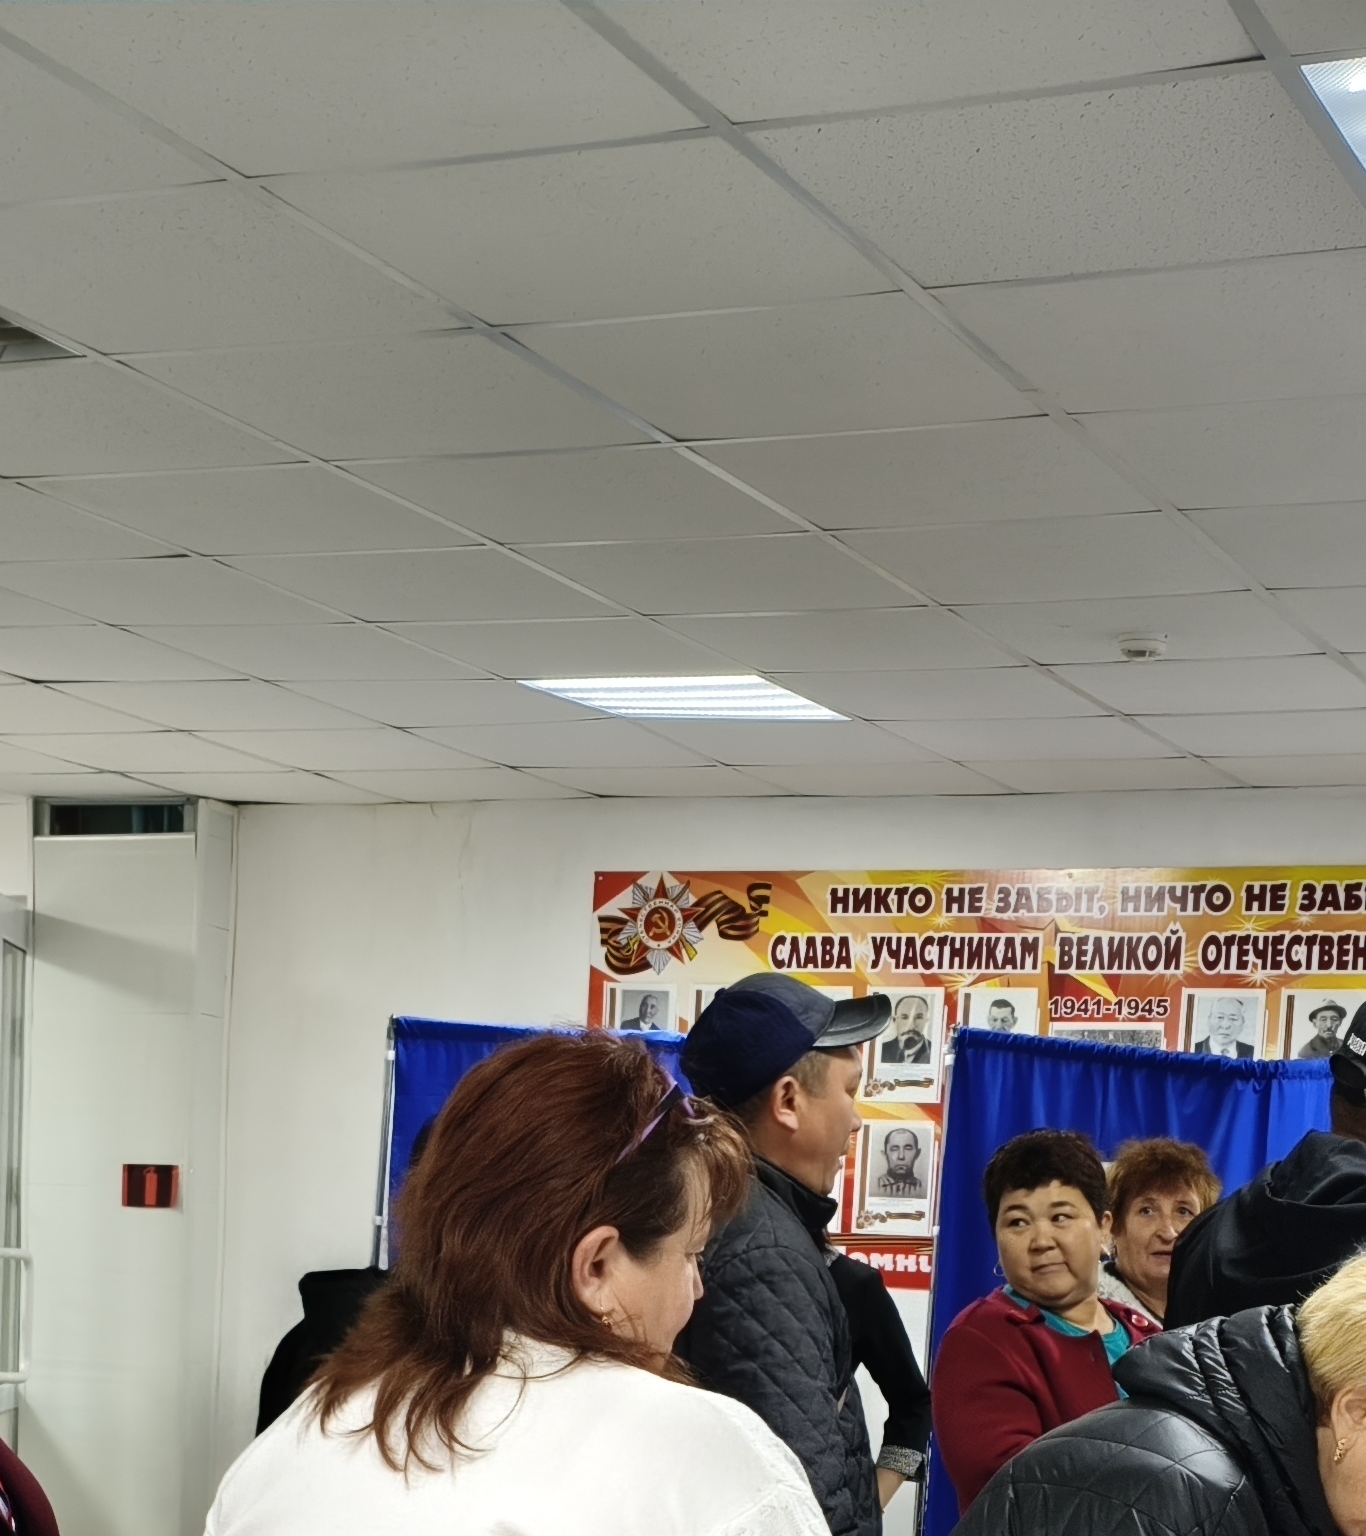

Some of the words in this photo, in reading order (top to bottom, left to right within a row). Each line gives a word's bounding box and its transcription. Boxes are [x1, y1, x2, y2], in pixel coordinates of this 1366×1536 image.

[829, 884, 933, 916] НИКТО
[945, 884, 987, 914] НЕ
[996, 884, 1108, 918] ЗАБЫТ,
[1119, 883, 1232, 915] НИЧТО
[1244, 882, 1287, 912] НЕ
[771, 934, 853, 971] СЛАВА
[870, 934, 1041, 972] УЧАСТНИКАМ
[1057, 926, 1183, 972] ВЕЛИКОЙ
[1048, 998, 1169, 1018] 1941-1945
